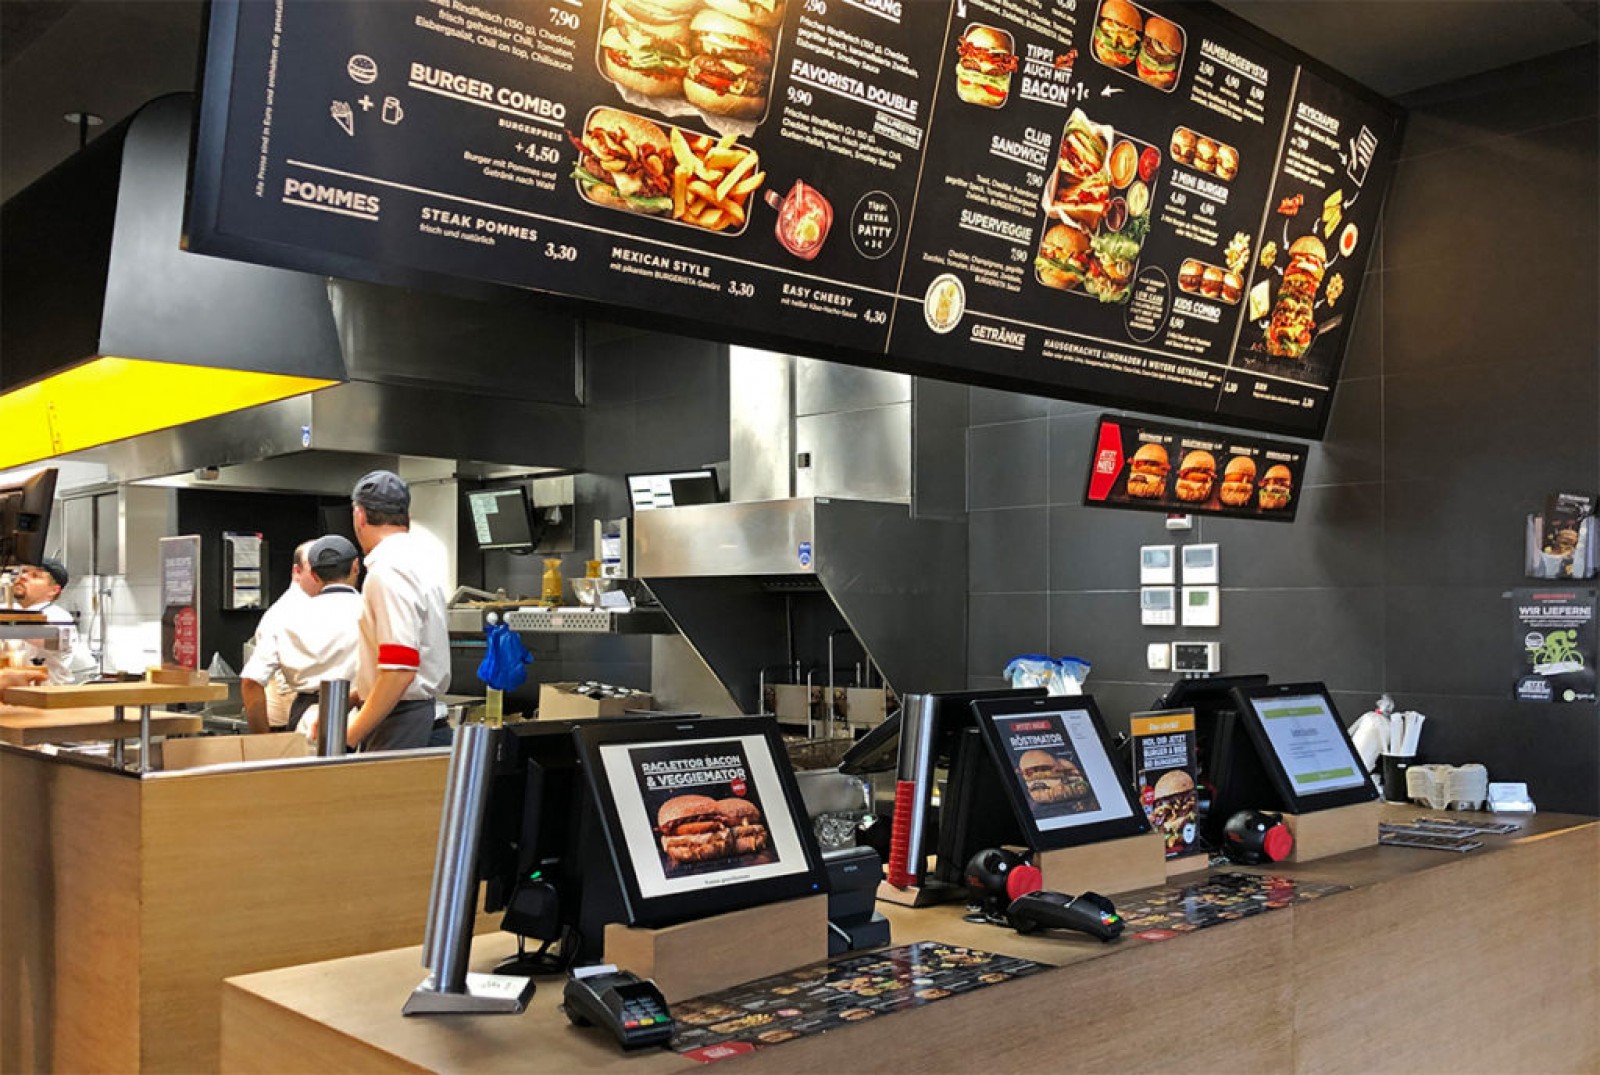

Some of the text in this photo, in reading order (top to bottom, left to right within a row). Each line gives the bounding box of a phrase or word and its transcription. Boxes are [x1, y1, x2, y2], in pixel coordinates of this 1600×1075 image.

[549, 7, 580, 30] 7,90
[1027, 43, 1053, 62] TIPP!
[1023, 61, 1073, 85] AUCH MIT
[410, 62, 566, 120] BURGER COMBO
[787, 86, 813, 106] 9,90
[791, 58, 918, 114] FAVORISTA DOUBLE
[1021, 76, 1070, 103] BACON
[498, 118, 563, 141] BURGERPREIS
[1024, 127, 1050, 147] CLUB
[991, 135, 1048, 167] SANDWICH
[284, 177, 380, 214] POMMES
[421, 207, 539, 242] STEAK POMMES
[863, 212, 889, 223] EXTRA
[960, 208, 1034, 240] SUPERVEGGIE
[858, 224, 892, 238] PATTY
[544, 242, 578, 262] 3,30
[611, 247, 711, 278] MEXICAN STYLE
[727, 280, 755, 298] 3,30
[782, 283, 853, 307] EASY CHEESY
[863, 309, 887, 325] 4,30
[1174, 296, 1222, 318] KIDS COMBO
[972, 324, 1026, 346] GETRÄNKE
[1044, 339, 1101, 359] HAUSGEMACHTE
[1102, 351, 1141, 366] LIMONADEN
[1176, 365, 1209, 379] GETRÄNKE
[1518, 606, 1541, 616] WIR
[1009, 732, 1063, 747] RÖSTIMATOR
[641, 754, 741, 774] RACLETTOR BACON
[646, 767, 746, 788] & VEGGIEMATOR
